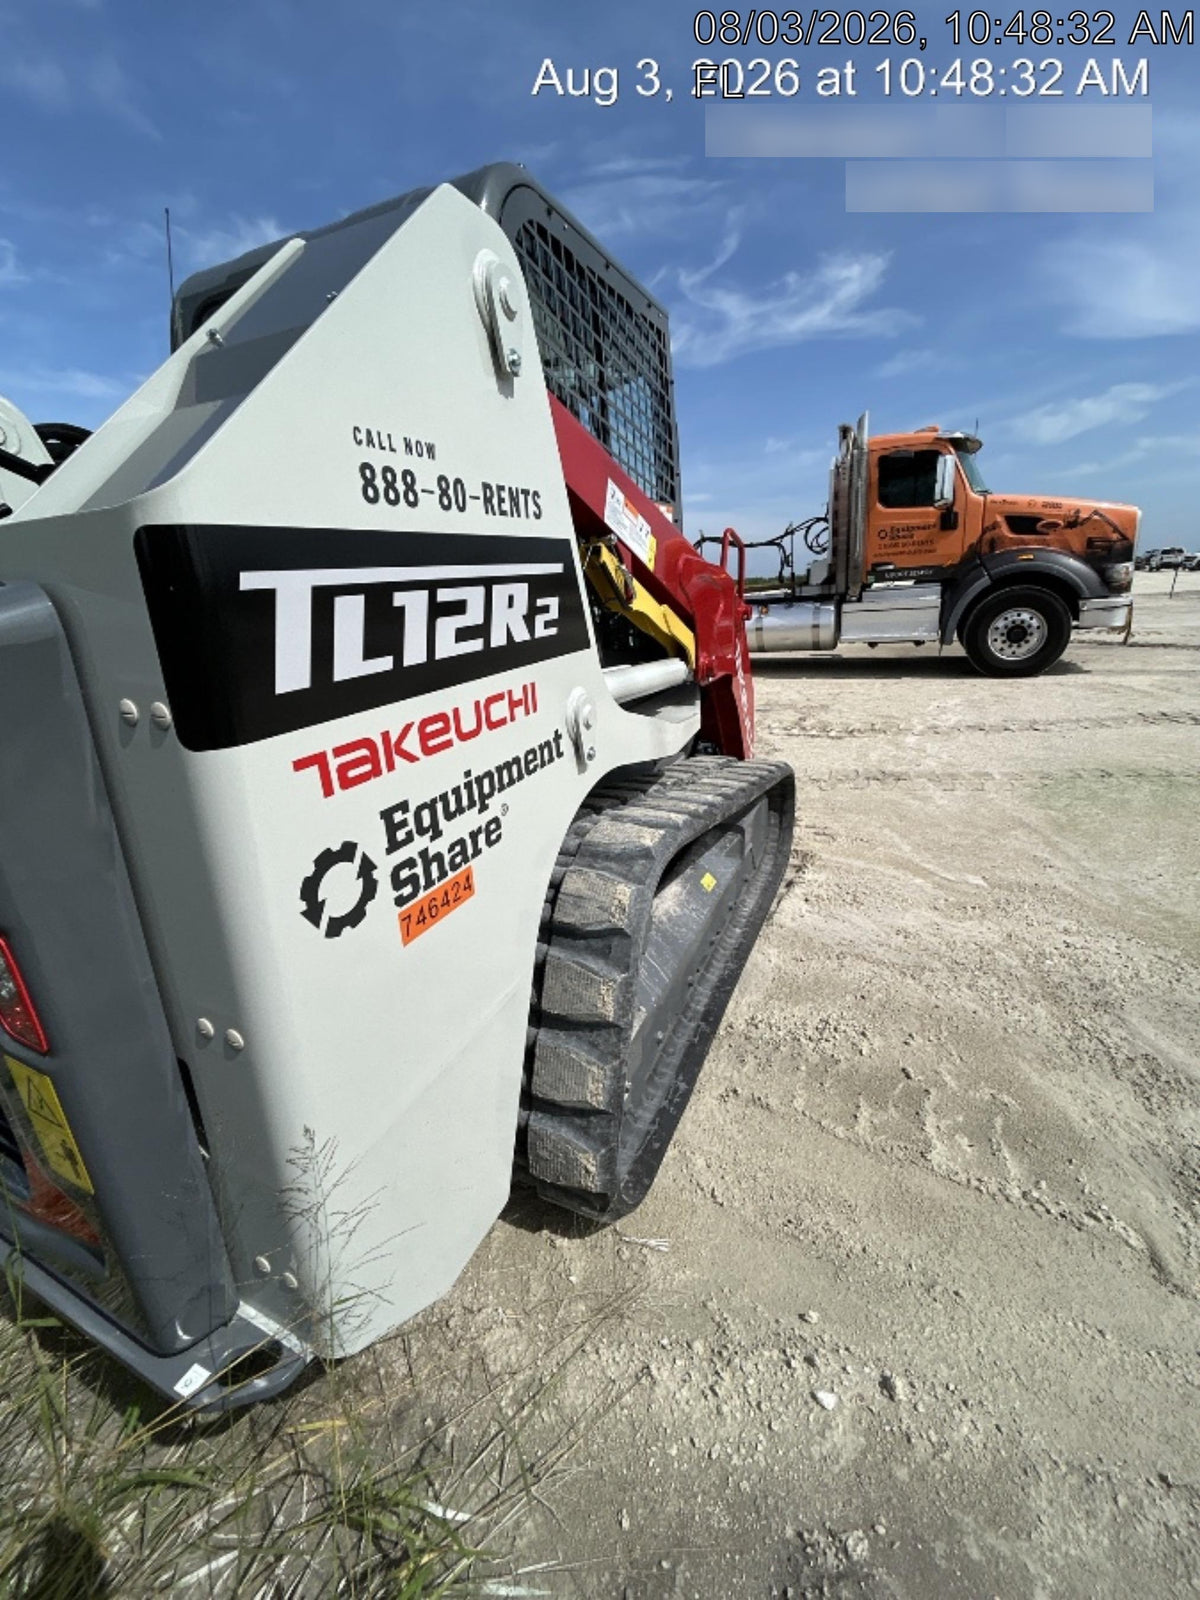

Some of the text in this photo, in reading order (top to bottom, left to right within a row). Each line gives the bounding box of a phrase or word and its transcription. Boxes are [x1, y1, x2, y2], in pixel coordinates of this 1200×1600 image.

[352, 425, 437, 461] CALL NOW
[358, 461, 543, 520] 888-80-RENTS
[239, 562, 564, 696] TL12R2
[380, 728, 564, 856] Equipment
[390, 815, 503, 908] Share
[400, 873, 473, 938] 746424
